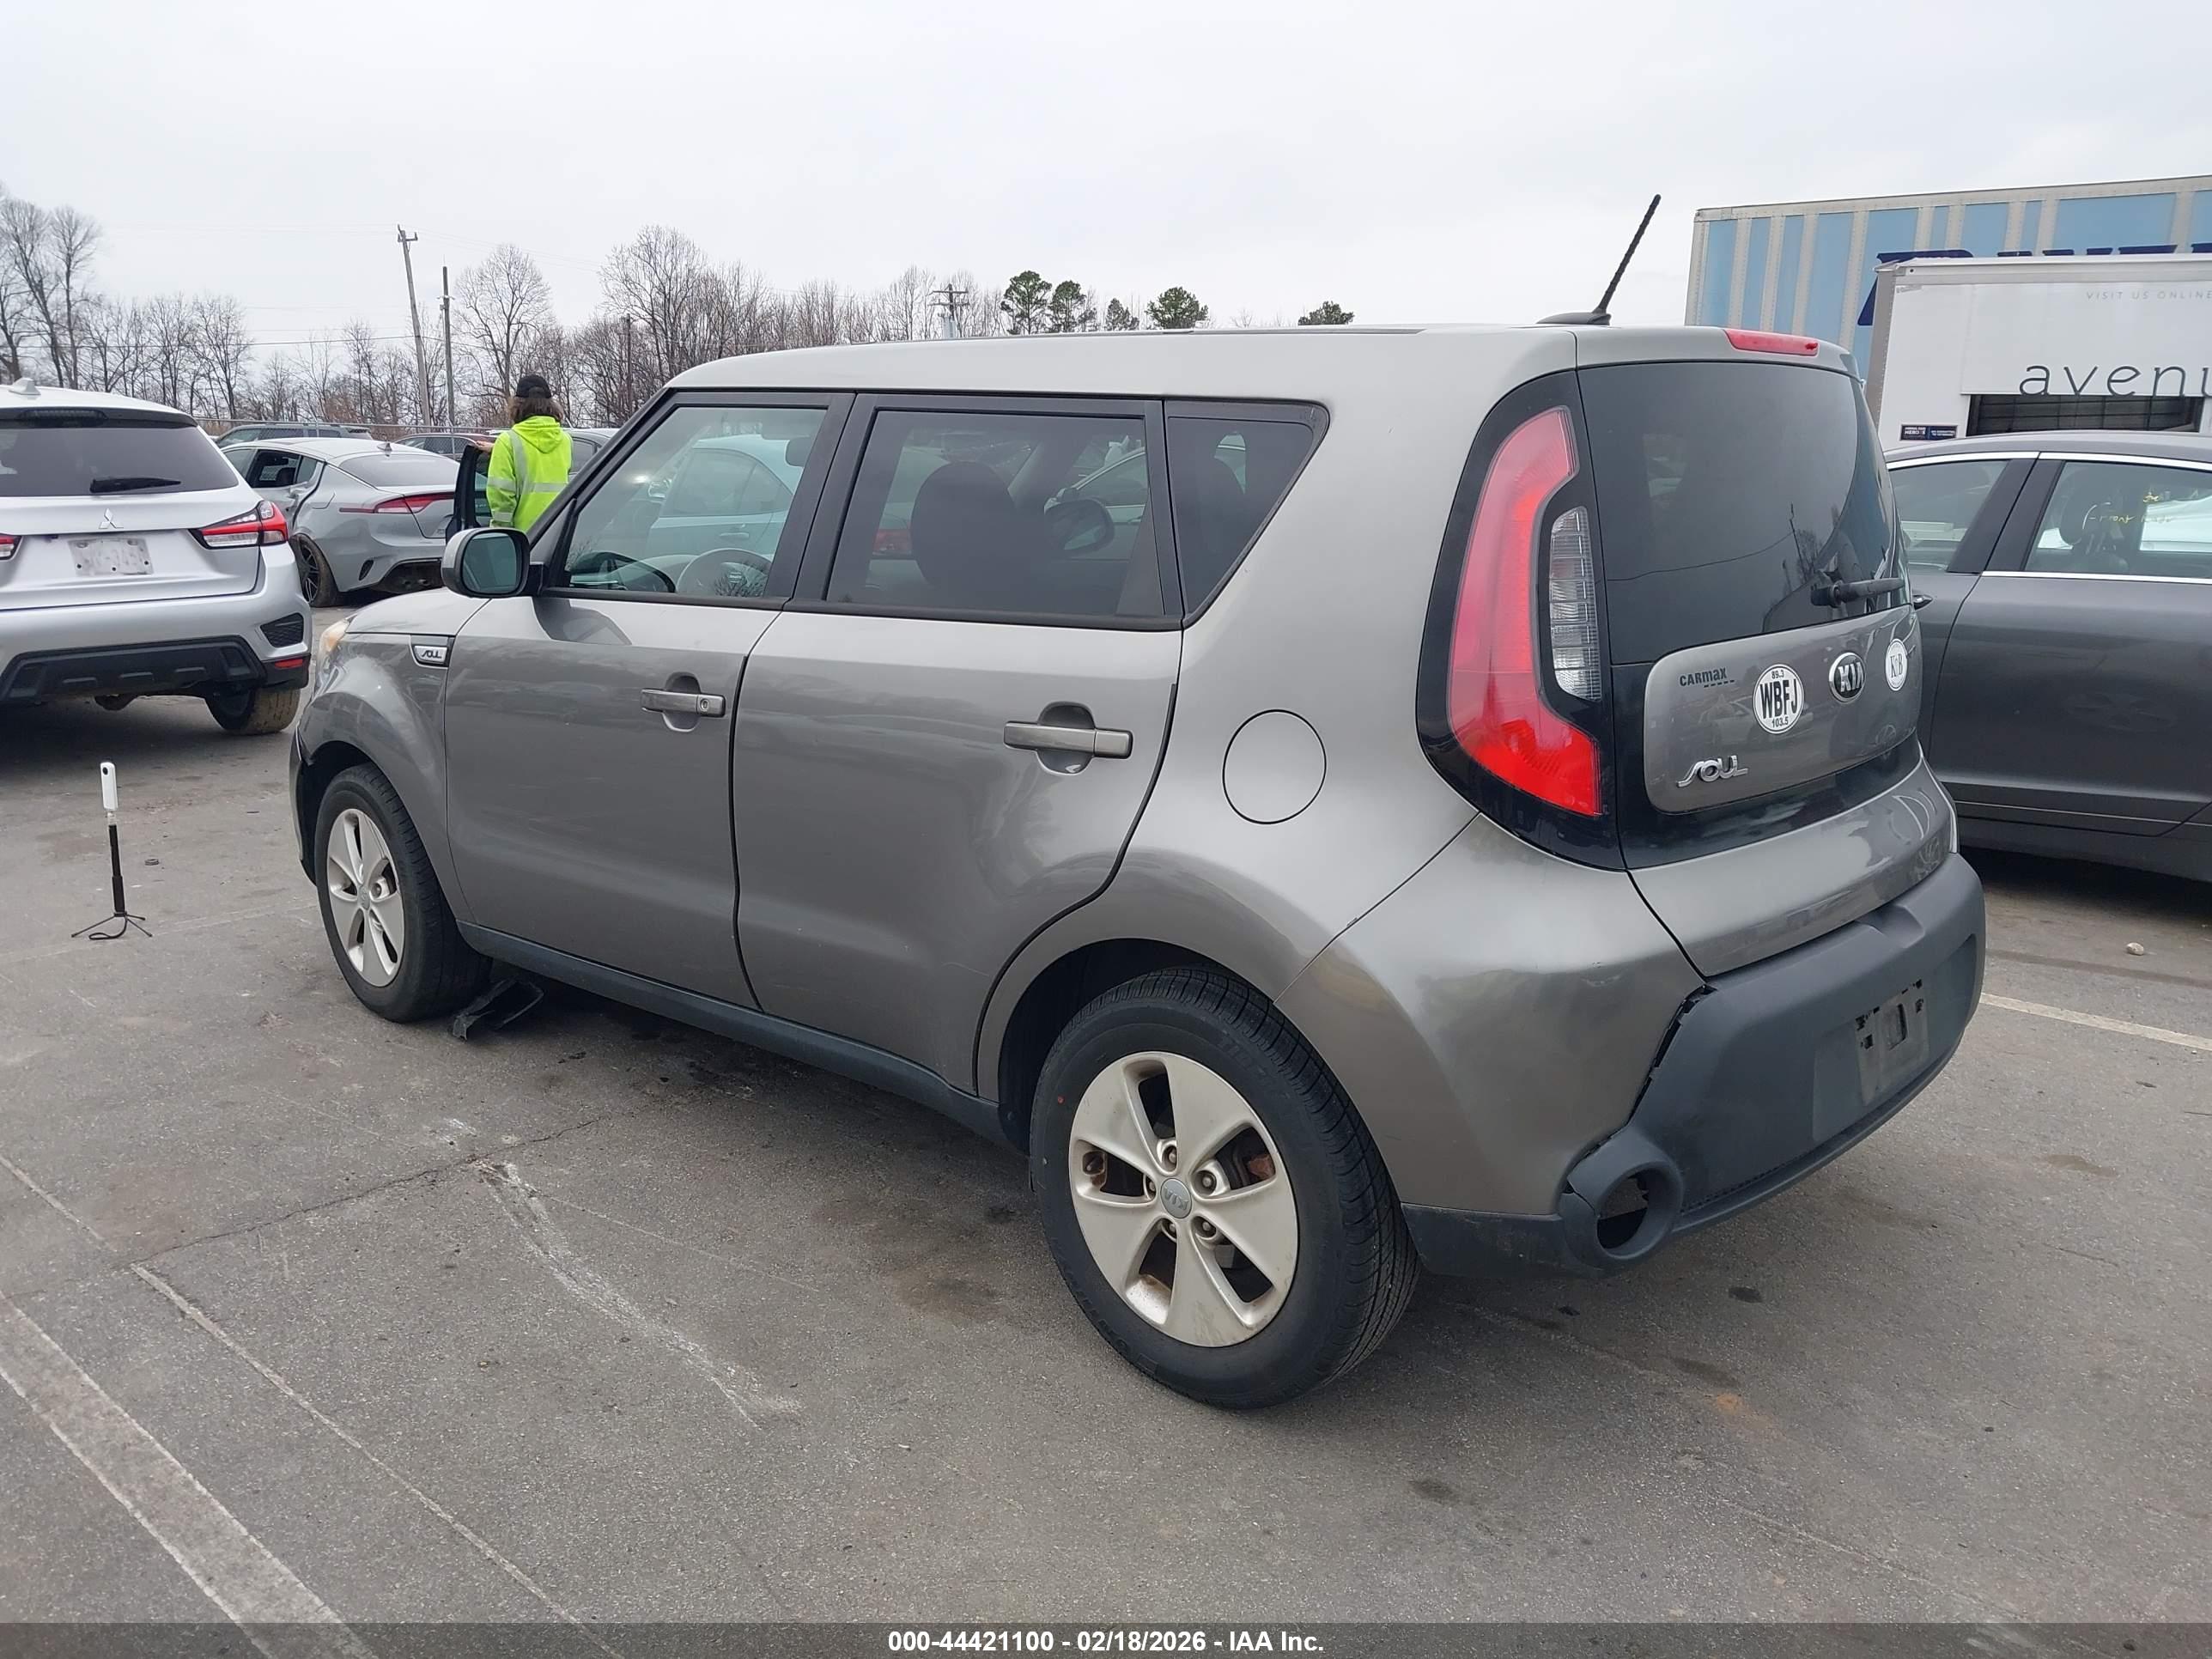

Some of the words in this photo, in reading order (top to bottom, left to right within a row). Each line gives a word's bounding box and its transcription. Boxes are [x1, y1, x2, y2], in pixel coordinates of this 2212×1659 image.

[2086, 291, 2124, 301] VISIT
[2131, 291, 2149, 300] US
[2157, 289, 2212, 300] ONLINE
[2020, 366, 2212, 398] aven
[1771, 669, 1785, 680] 89.3
[1838, 661, 1865, 693] KIA
[1759, 678, 1798, 720] WBFJ
[1771, 717, 1789, 728] 103.5
[1676, 755, 1749, 787] SOUL
